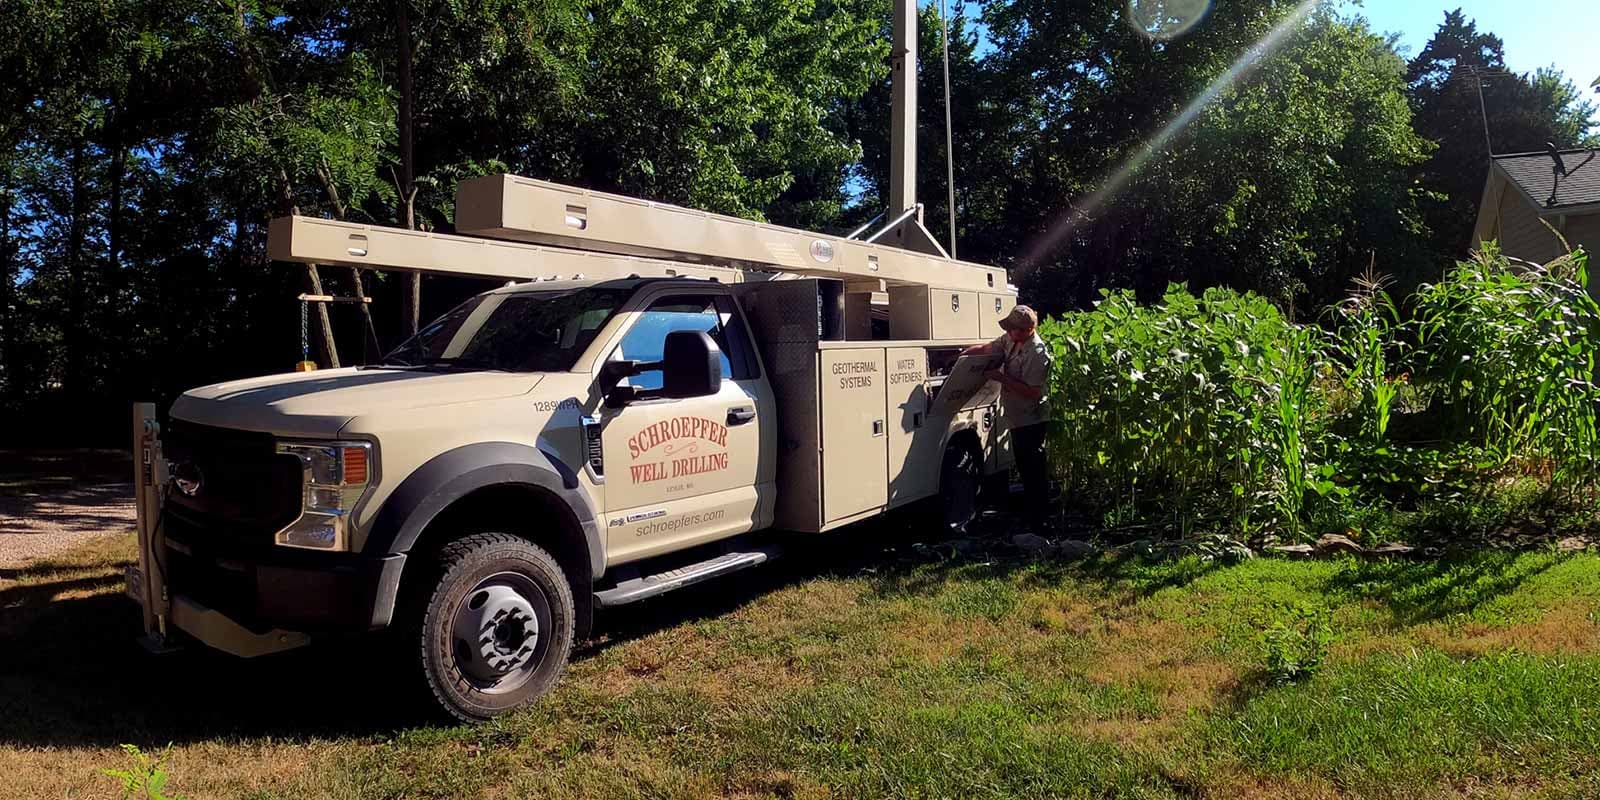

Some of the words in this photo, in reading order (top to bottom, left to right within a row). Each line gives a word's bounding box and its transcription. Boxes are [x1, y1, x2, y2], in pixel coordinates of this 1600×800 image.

[832, 361, 878, 375] GEOTHERMAL
[897, 359, 915, 370] WATER
[840, 376, 872, 389] SYSTEMS
[889, 371, 922, 384] SOFTENERS
[628, 416, 728, 460] SCHROEPFER
[630, 462, 668, 484] WELL
[672, 452, 728, 478] DRILLING
[635, 509, 725, 537] schroepfers.com
